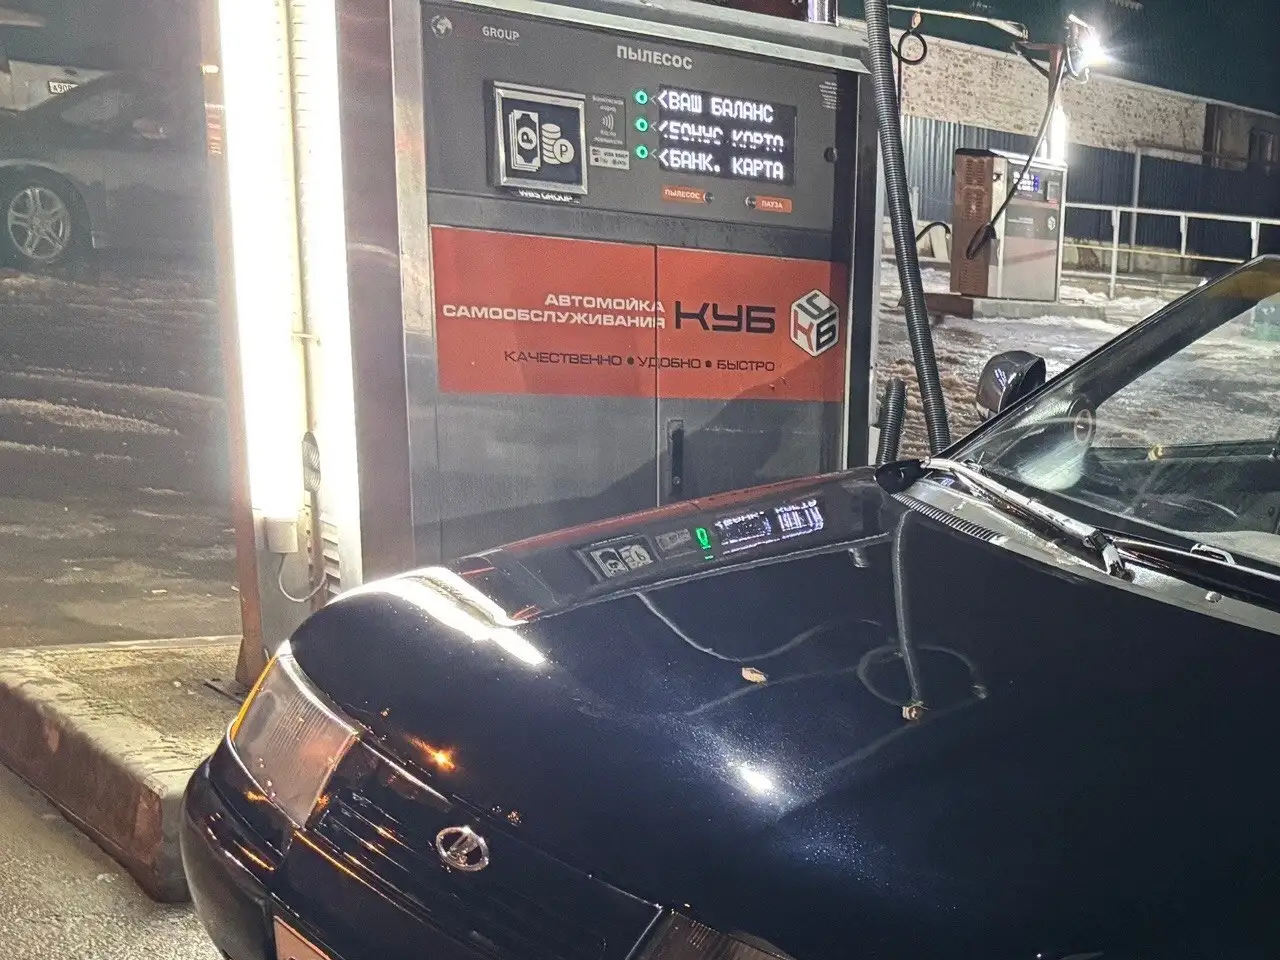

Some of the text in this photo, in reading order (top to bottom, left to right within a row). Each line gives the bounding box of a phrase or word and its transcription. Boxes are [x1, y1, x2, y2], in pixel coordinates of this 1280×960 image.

[482, 26, 520, 40] GROUP
[616, 45, 693, 70] ПЫЛЕСОС
[711, 97, 774, 123] БАЛАНС
[732, 156, 784, 180] КАРТА
[664, 189, 700, 199] ПЫЛЕСОС
[761, 200, 783, 209] ПАУЗА
[545, 294, 666, 313] АВТОМОЙКА
[443, 305, 666, 329] САМООБСЛУЖИВАНИЯ
[675, 301, 776, 334] КУБ
[504, 351, 775, 372] КАЧЕСТВЕННО УДОБНО БЫСТРО
